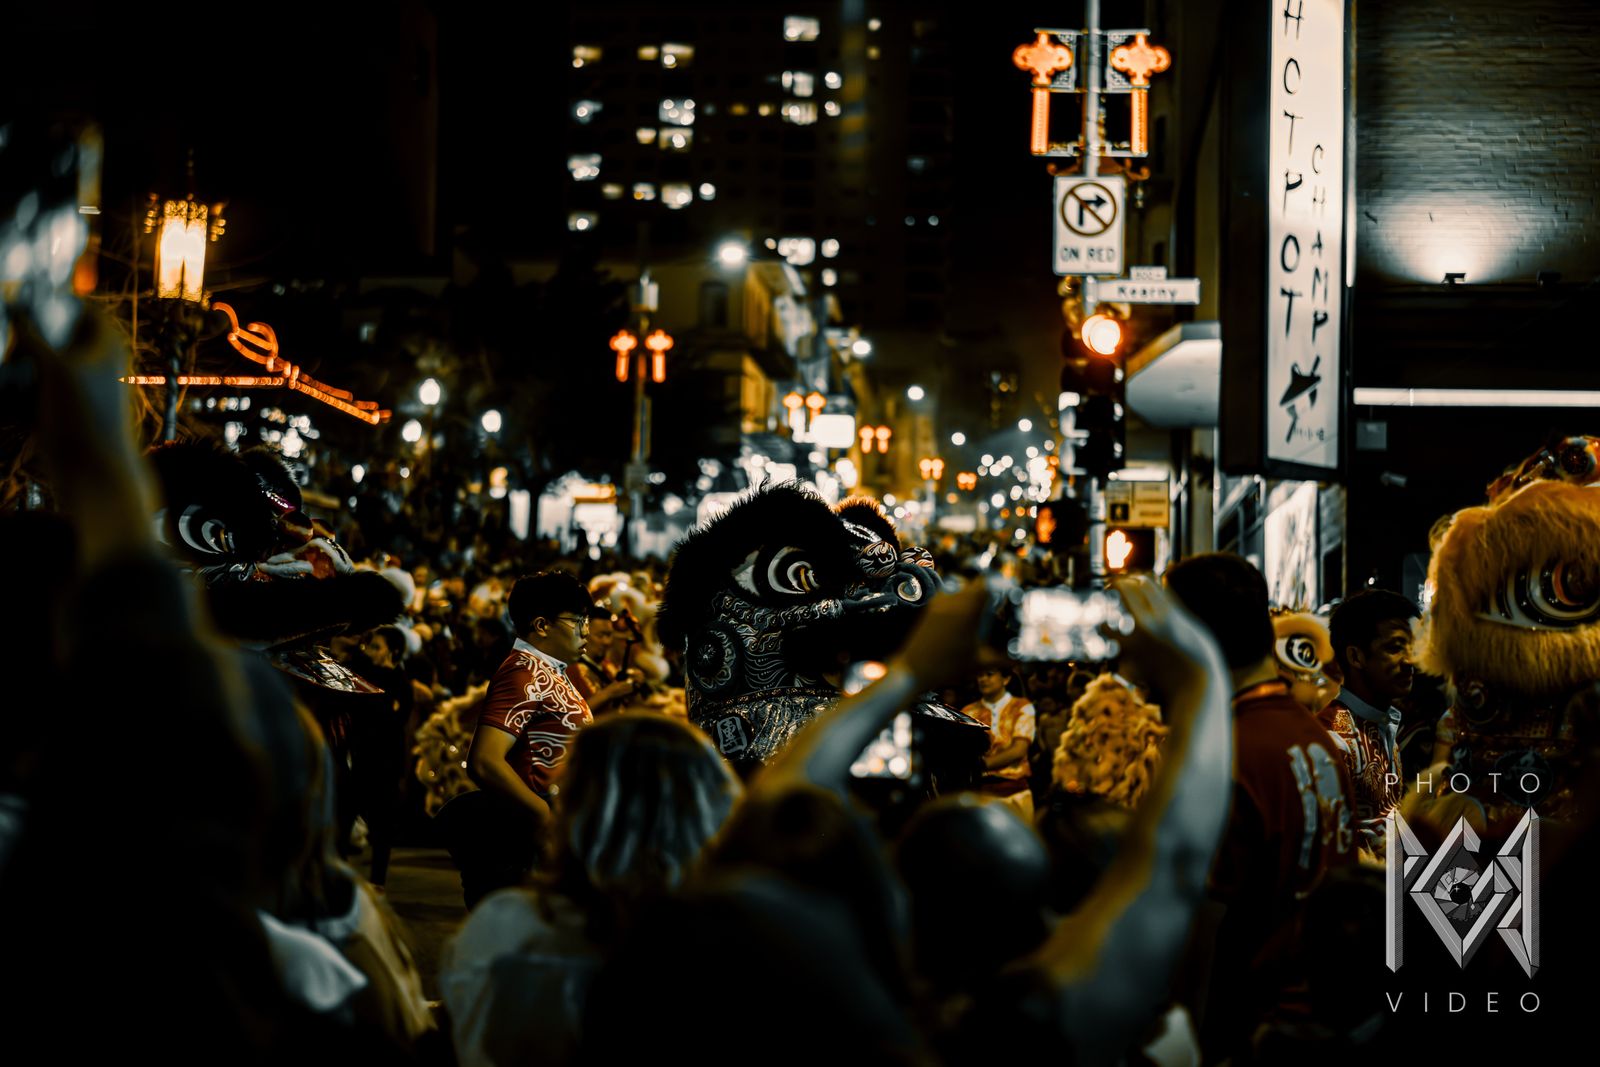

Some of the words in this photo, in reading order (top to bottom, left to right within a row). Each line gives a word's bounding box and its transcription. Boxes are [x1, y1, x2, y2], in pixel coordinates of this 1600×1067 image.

[1280, 0, 1305, 338] HOTPOT
[1061, 248, 1080, 261] ON
[1087, 248, 1115, 262] RED
[1117, 286, 1178, 302] Kearny
[1311, 144, 1330, 344] CHAMP
